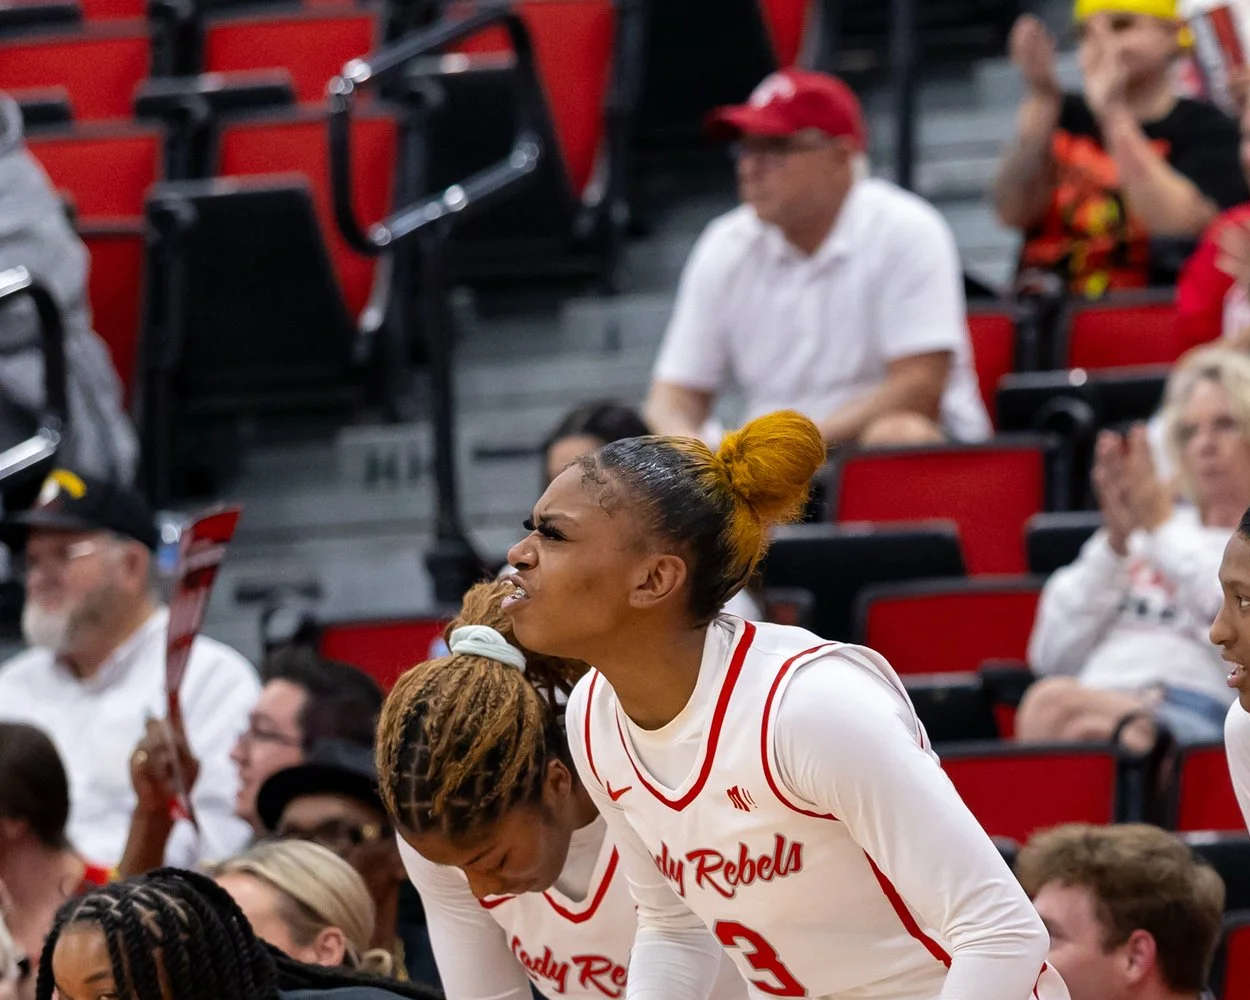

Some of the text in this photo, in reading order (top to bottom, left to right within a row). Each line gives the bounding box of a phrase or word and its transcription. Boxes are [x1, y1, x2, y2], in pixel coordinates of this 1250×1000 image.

[654, 833, 805, 900] dy Rebels
[712, 919, 810, 998] 3
